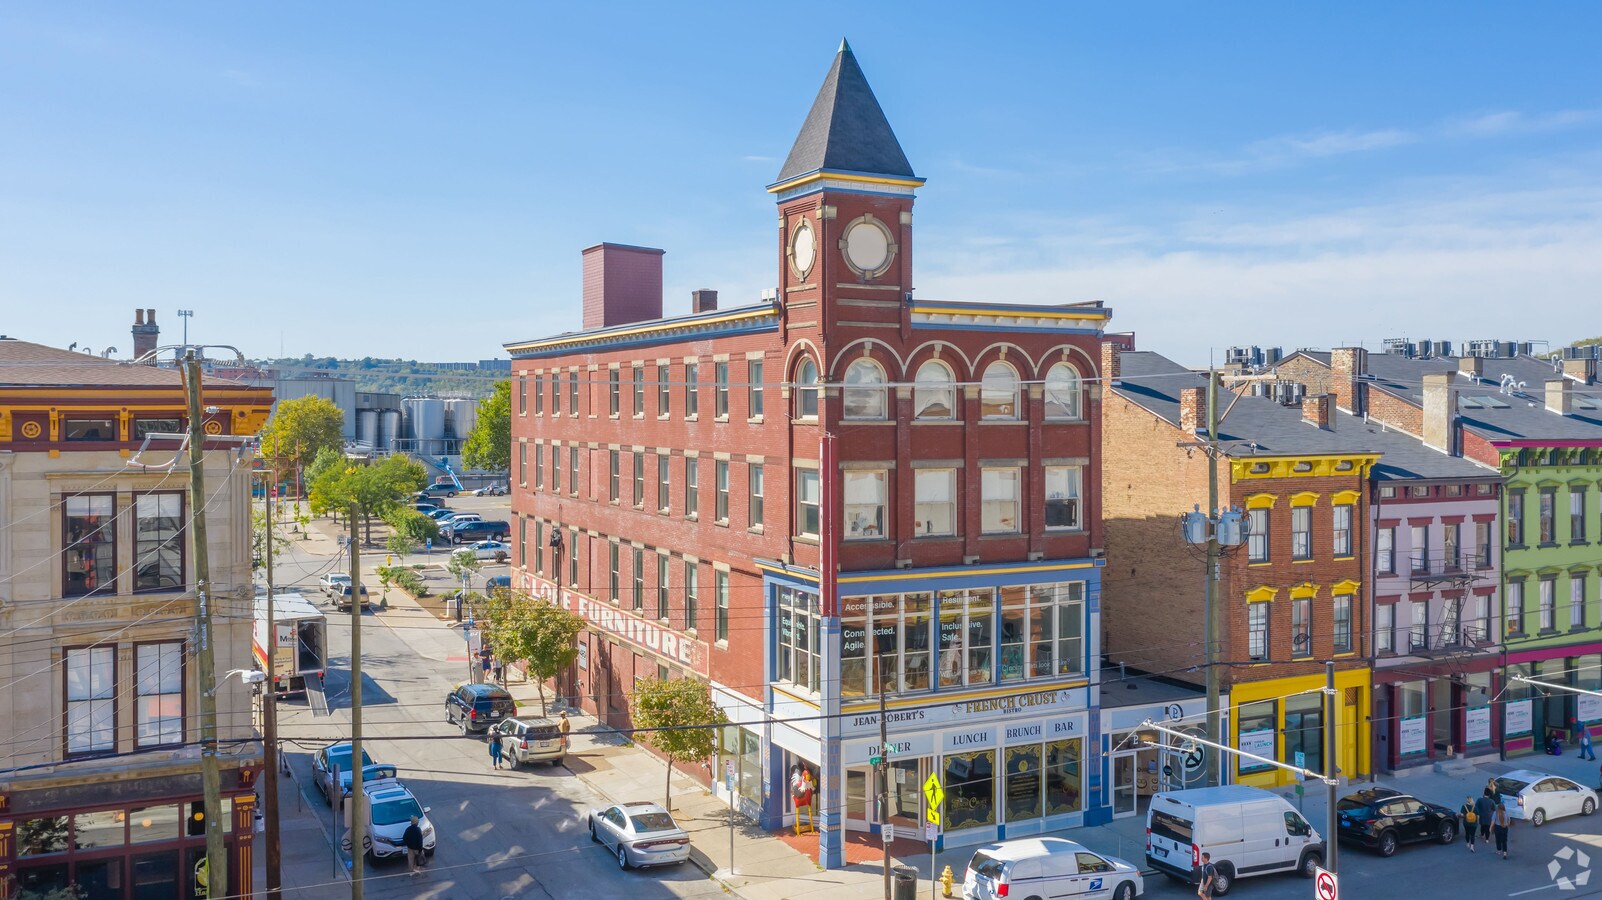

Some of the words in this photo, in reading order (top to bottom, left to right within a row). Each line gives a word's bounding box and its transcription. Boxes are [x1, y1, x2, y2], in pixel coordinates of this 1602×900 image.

[578, 597, 692, 664] FURNITURE
[843, 626, 896, 638] Connected.
[941, 632, 961, 642] Safe.
[843, 640, 866, 652] Agile.
[966, 694, 1017, 713] FRENCH
[1018, 692, 1057, 707] CRUST
[1003, 706, 1022, 714] BISTRO
[853, 710, 925, 727] JEAN-OBERT'S
[1006, 725, 1041, 739] BRUNCH
[1054, 721, 1074, 732] BAR
[953, 732, 987, 746] LUNCH
[868, 741, 911, 756] DINER
